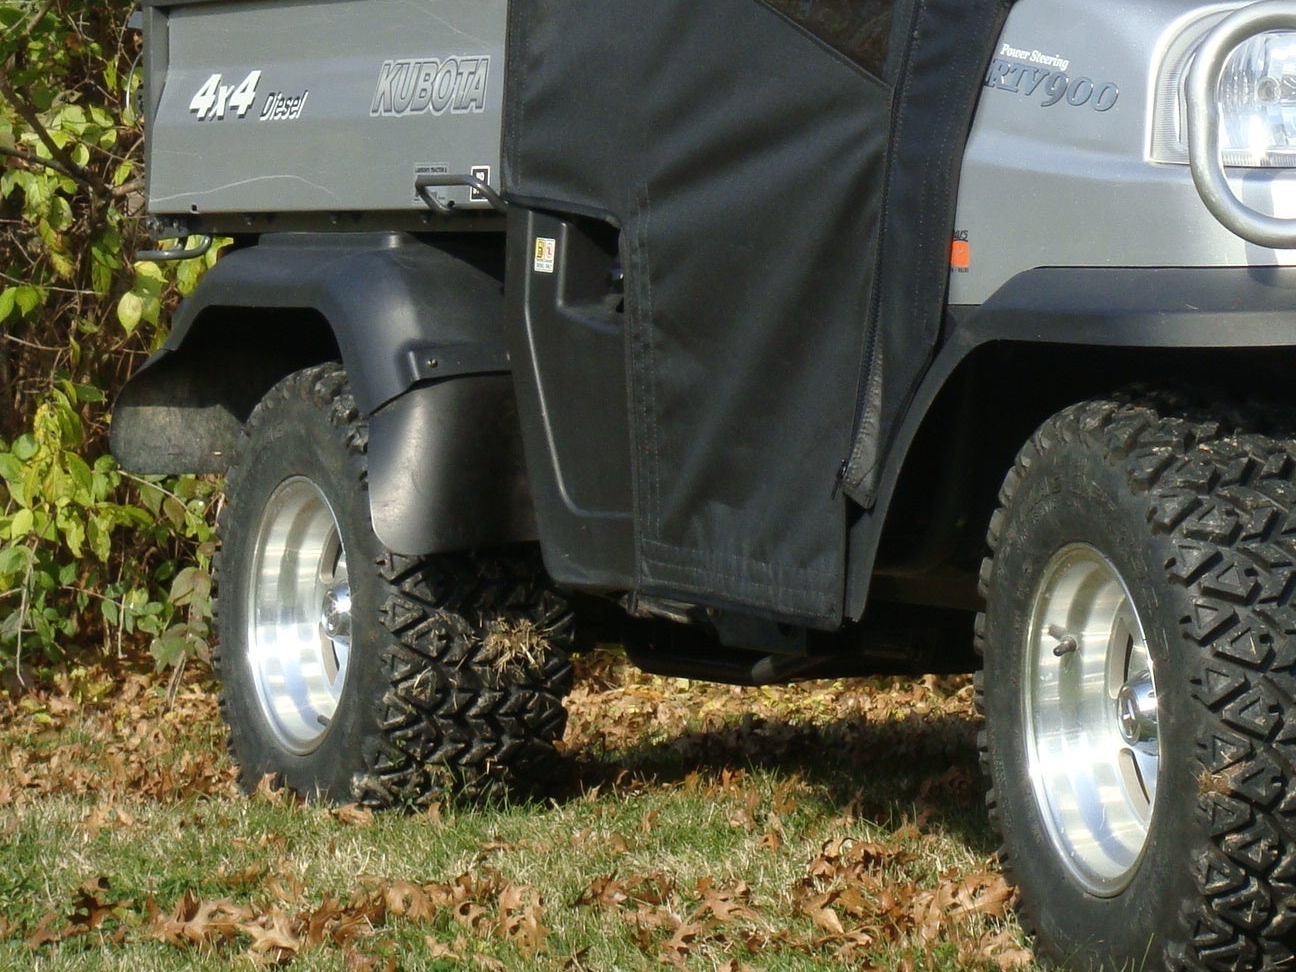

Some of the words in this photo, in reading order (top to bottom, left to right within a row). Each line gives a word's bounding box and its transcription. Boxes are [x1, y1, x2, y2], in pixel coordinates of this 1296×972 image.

[1001, 44, 1030, 60] Power
[1030, 50, 1069, 71] Steering
[189, 69, 262, 121] 4x4
[260, 90, 308, 120] Diesel
[370, 55, 490, 116] KUBOTA
[985, 59, 1119, 112] RTV900
